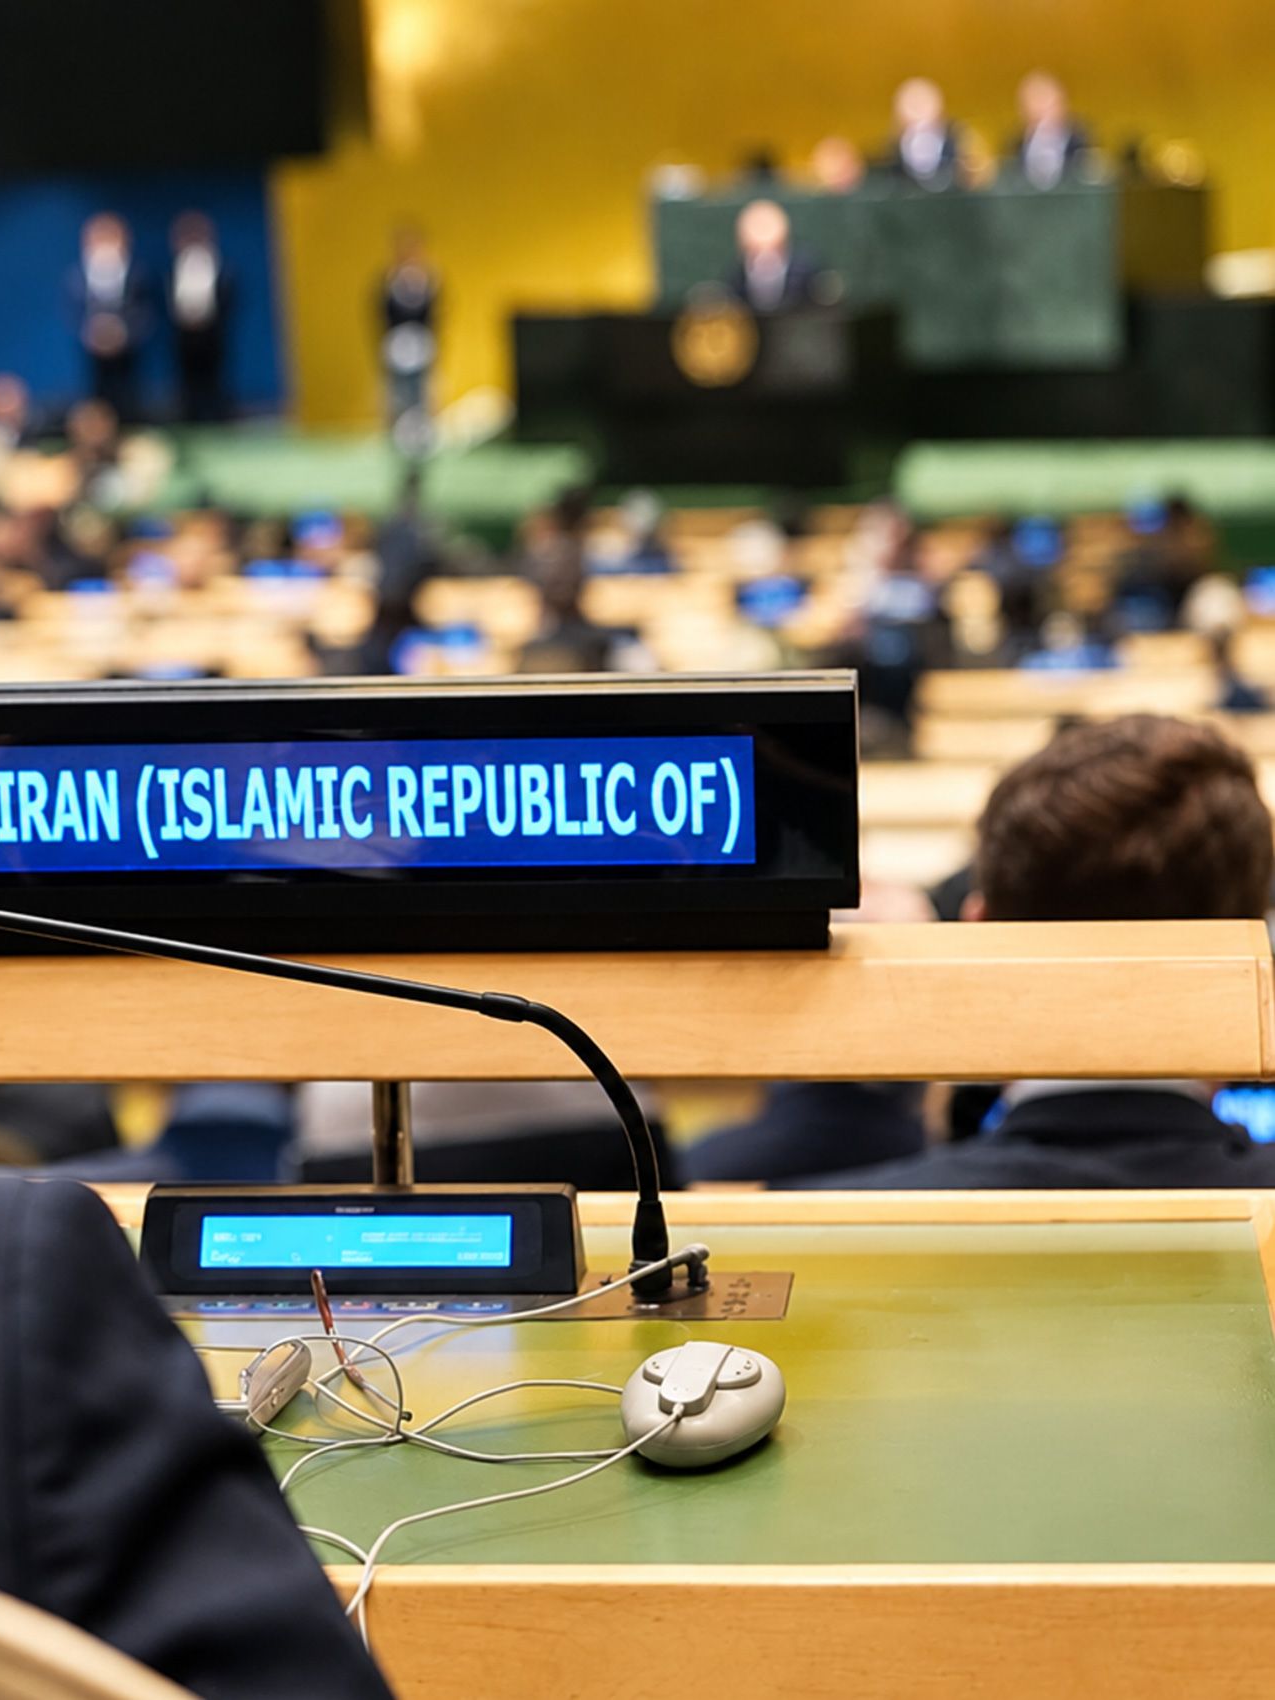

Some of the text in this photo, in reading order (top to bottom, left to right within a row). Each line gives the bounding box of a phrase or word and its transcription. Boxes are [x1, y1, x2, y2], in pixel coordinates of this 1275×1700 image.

[136, 764, 374, 859] (ISLAMIC
[387, 761, 637, 839] REPUBLIC
[650, 757, 742, 854] OF)
